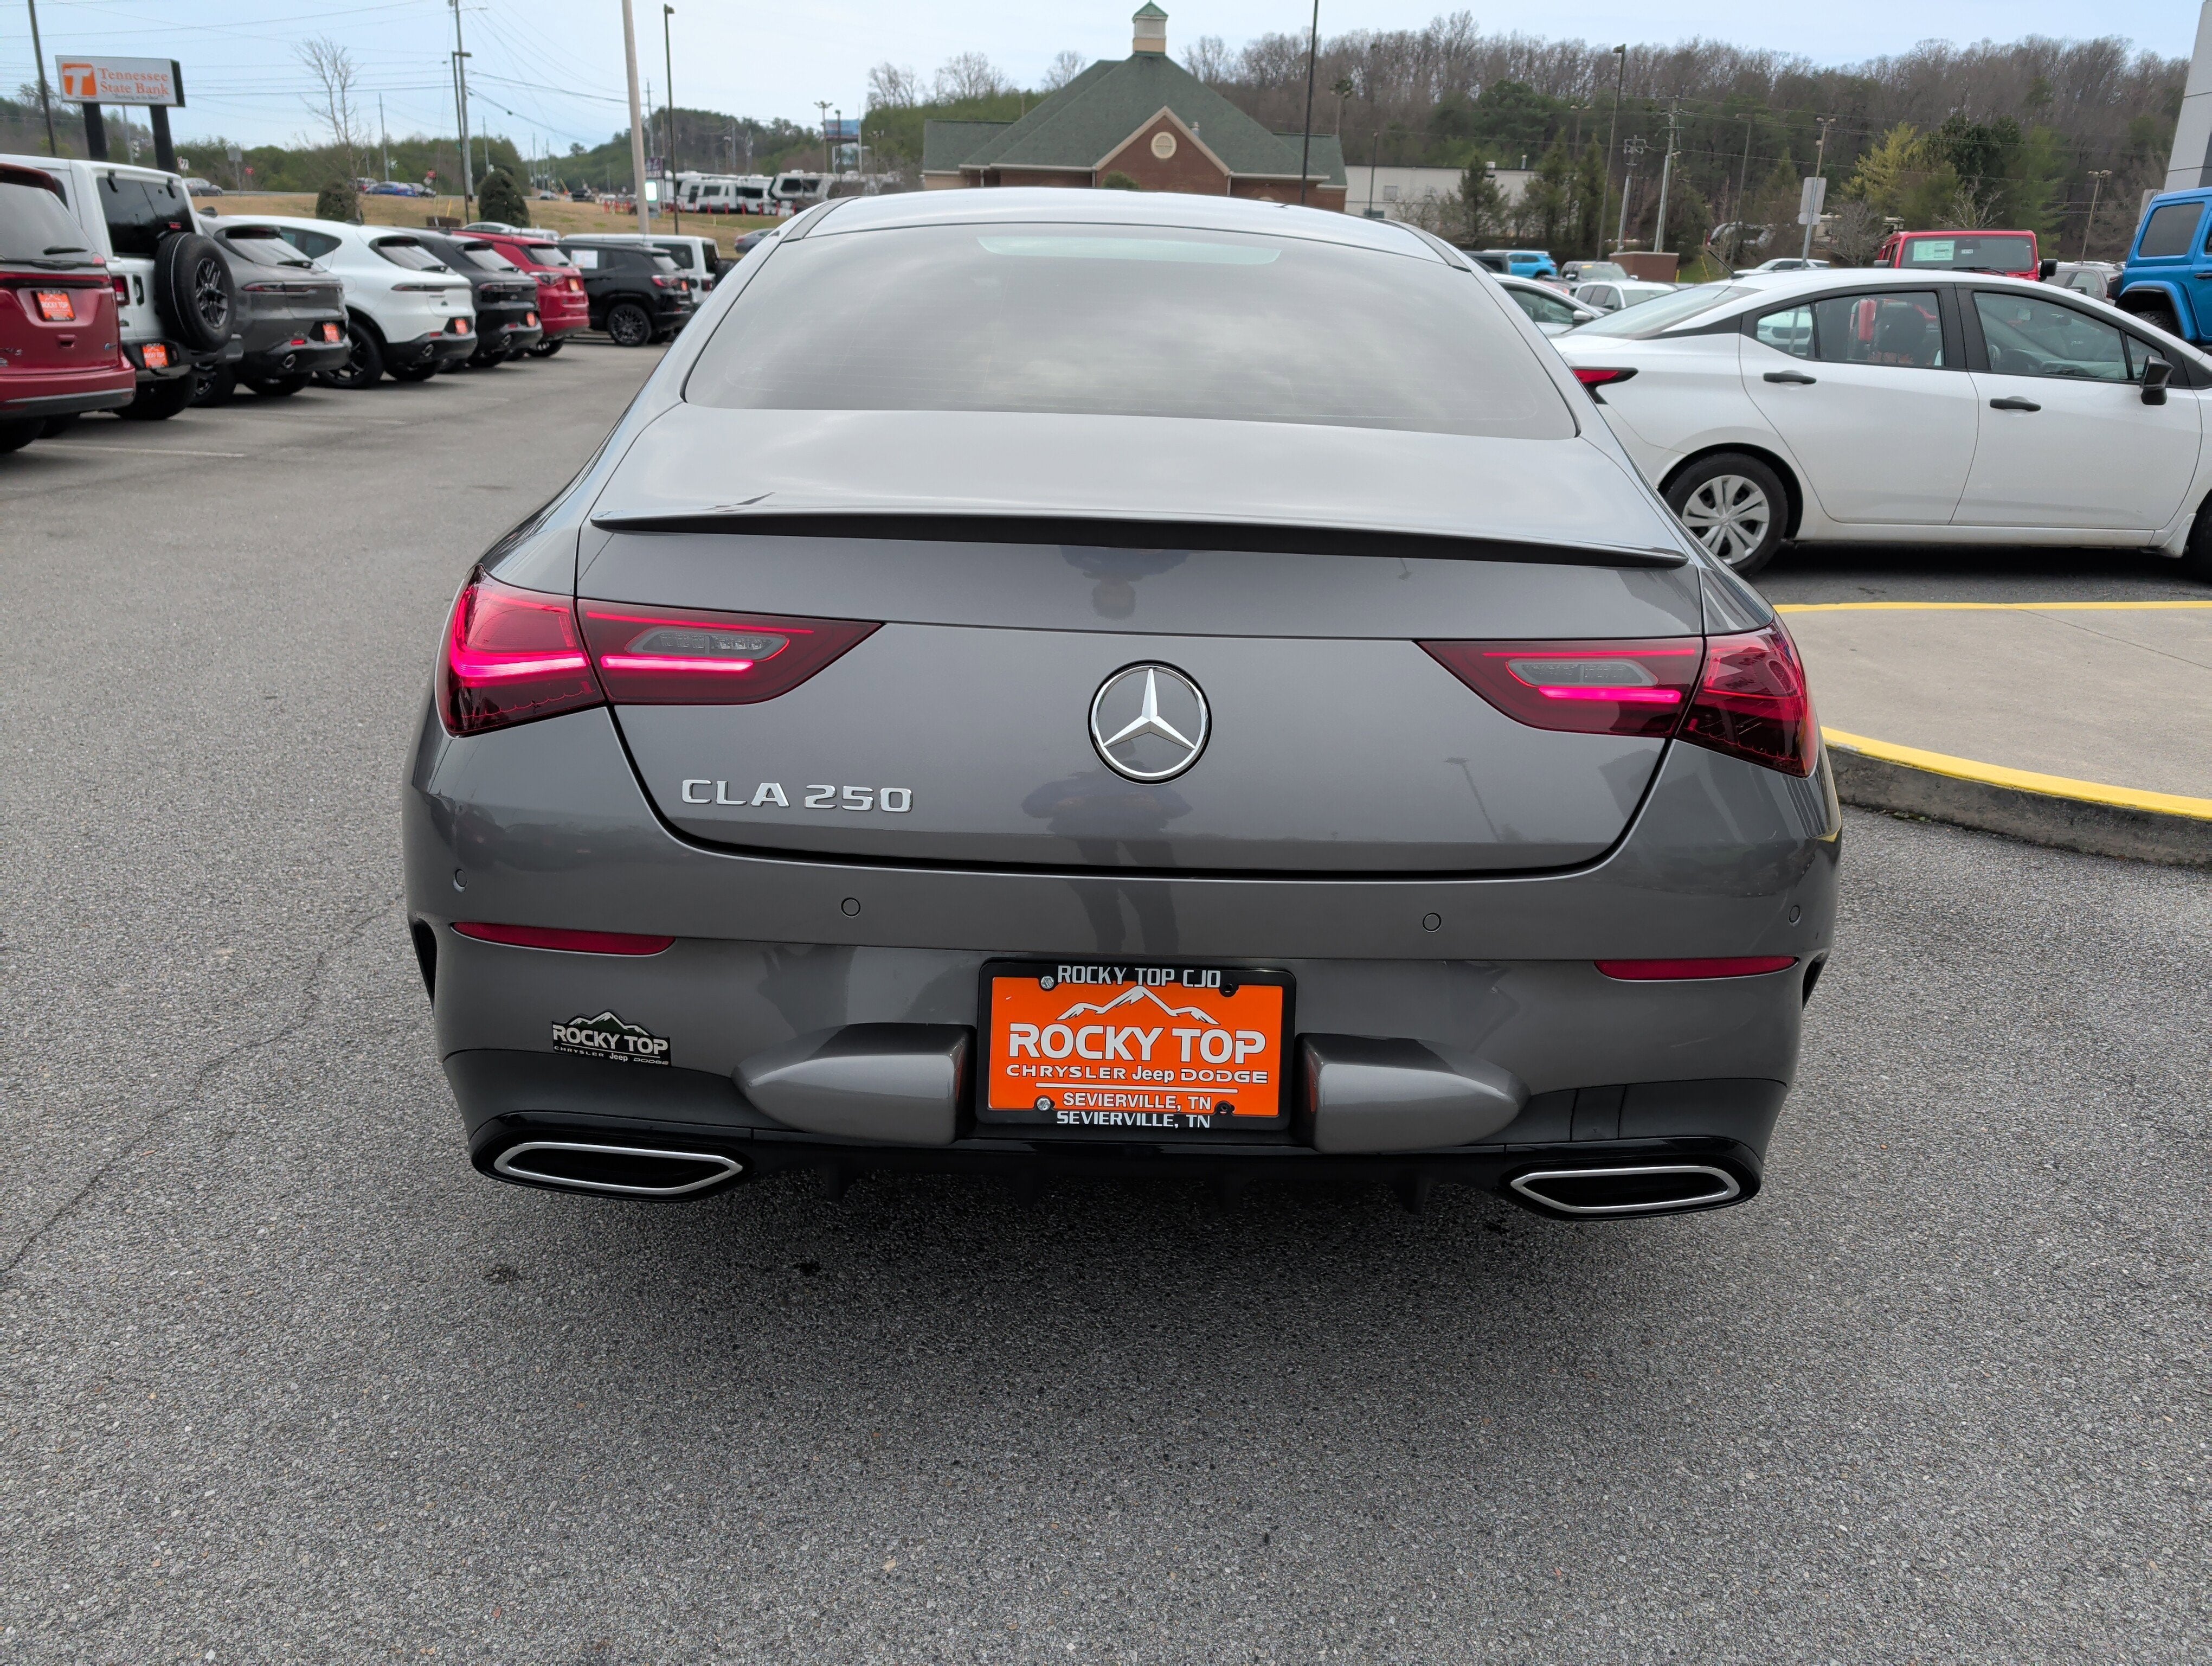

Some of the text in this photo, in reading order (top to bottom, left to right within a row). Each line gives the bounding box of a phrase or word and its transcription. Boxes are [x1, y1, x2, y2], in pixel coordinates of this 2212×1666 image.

[98, 68, 169, 81] Tennessee
[100, 81, 170, 95] State Bank
[682, 779, 913, 812] CLA 250
[1058, 965, 1220, 988] ROCKY TOP CJD
[552, 1024, 668, 1055] ROCKY TOP
[1009, 1023, 1266, 1064] ROCKY TOP
[554, 1046, 669, 1065] CHRYSLER Jeep DODGE
[1006, 1064, 1268, 1084] CHRYSLER Jeep DODGE
[1063, 1092, 1211, 1112] SEVIERVILLE, TN
[1057, 1111, 1210, 1129] SEVIERVILLE, TN
